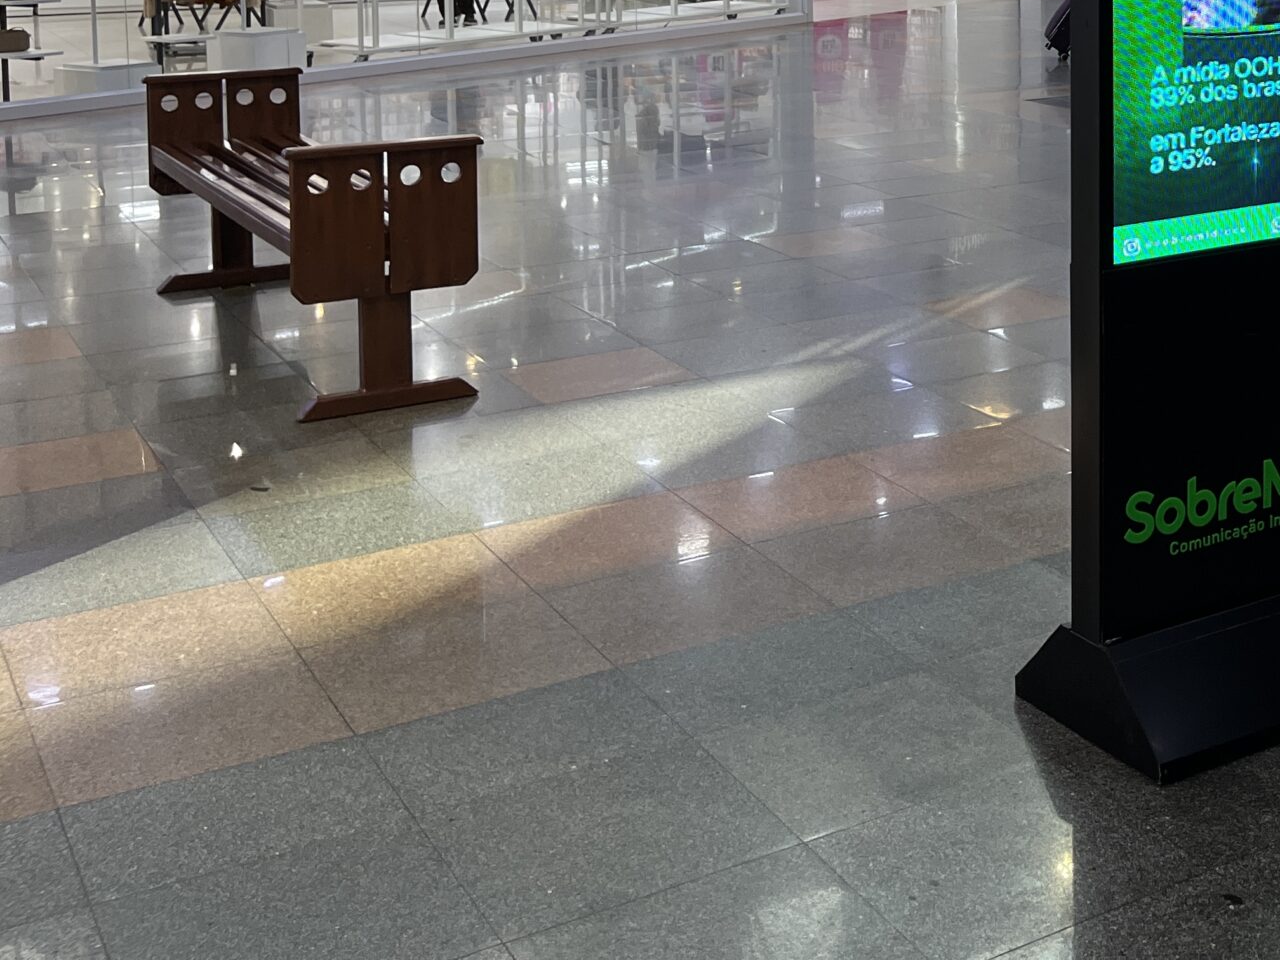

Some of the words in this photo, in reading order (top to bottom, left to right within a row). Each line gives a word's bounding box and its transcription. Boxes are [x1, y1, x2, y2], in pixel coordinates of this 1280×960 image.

[1151, 65, 1169, 87] A
[1174, 60, 1230, 85] mídia
[1200, 83, 1238, 103] dos
[1150, 131, 1186, 152] em
[1150, 155, 1164, 175] a
[1168, 147, 1217, 172] 95%.
[1169, 517, 1265, 556] Comunicação
